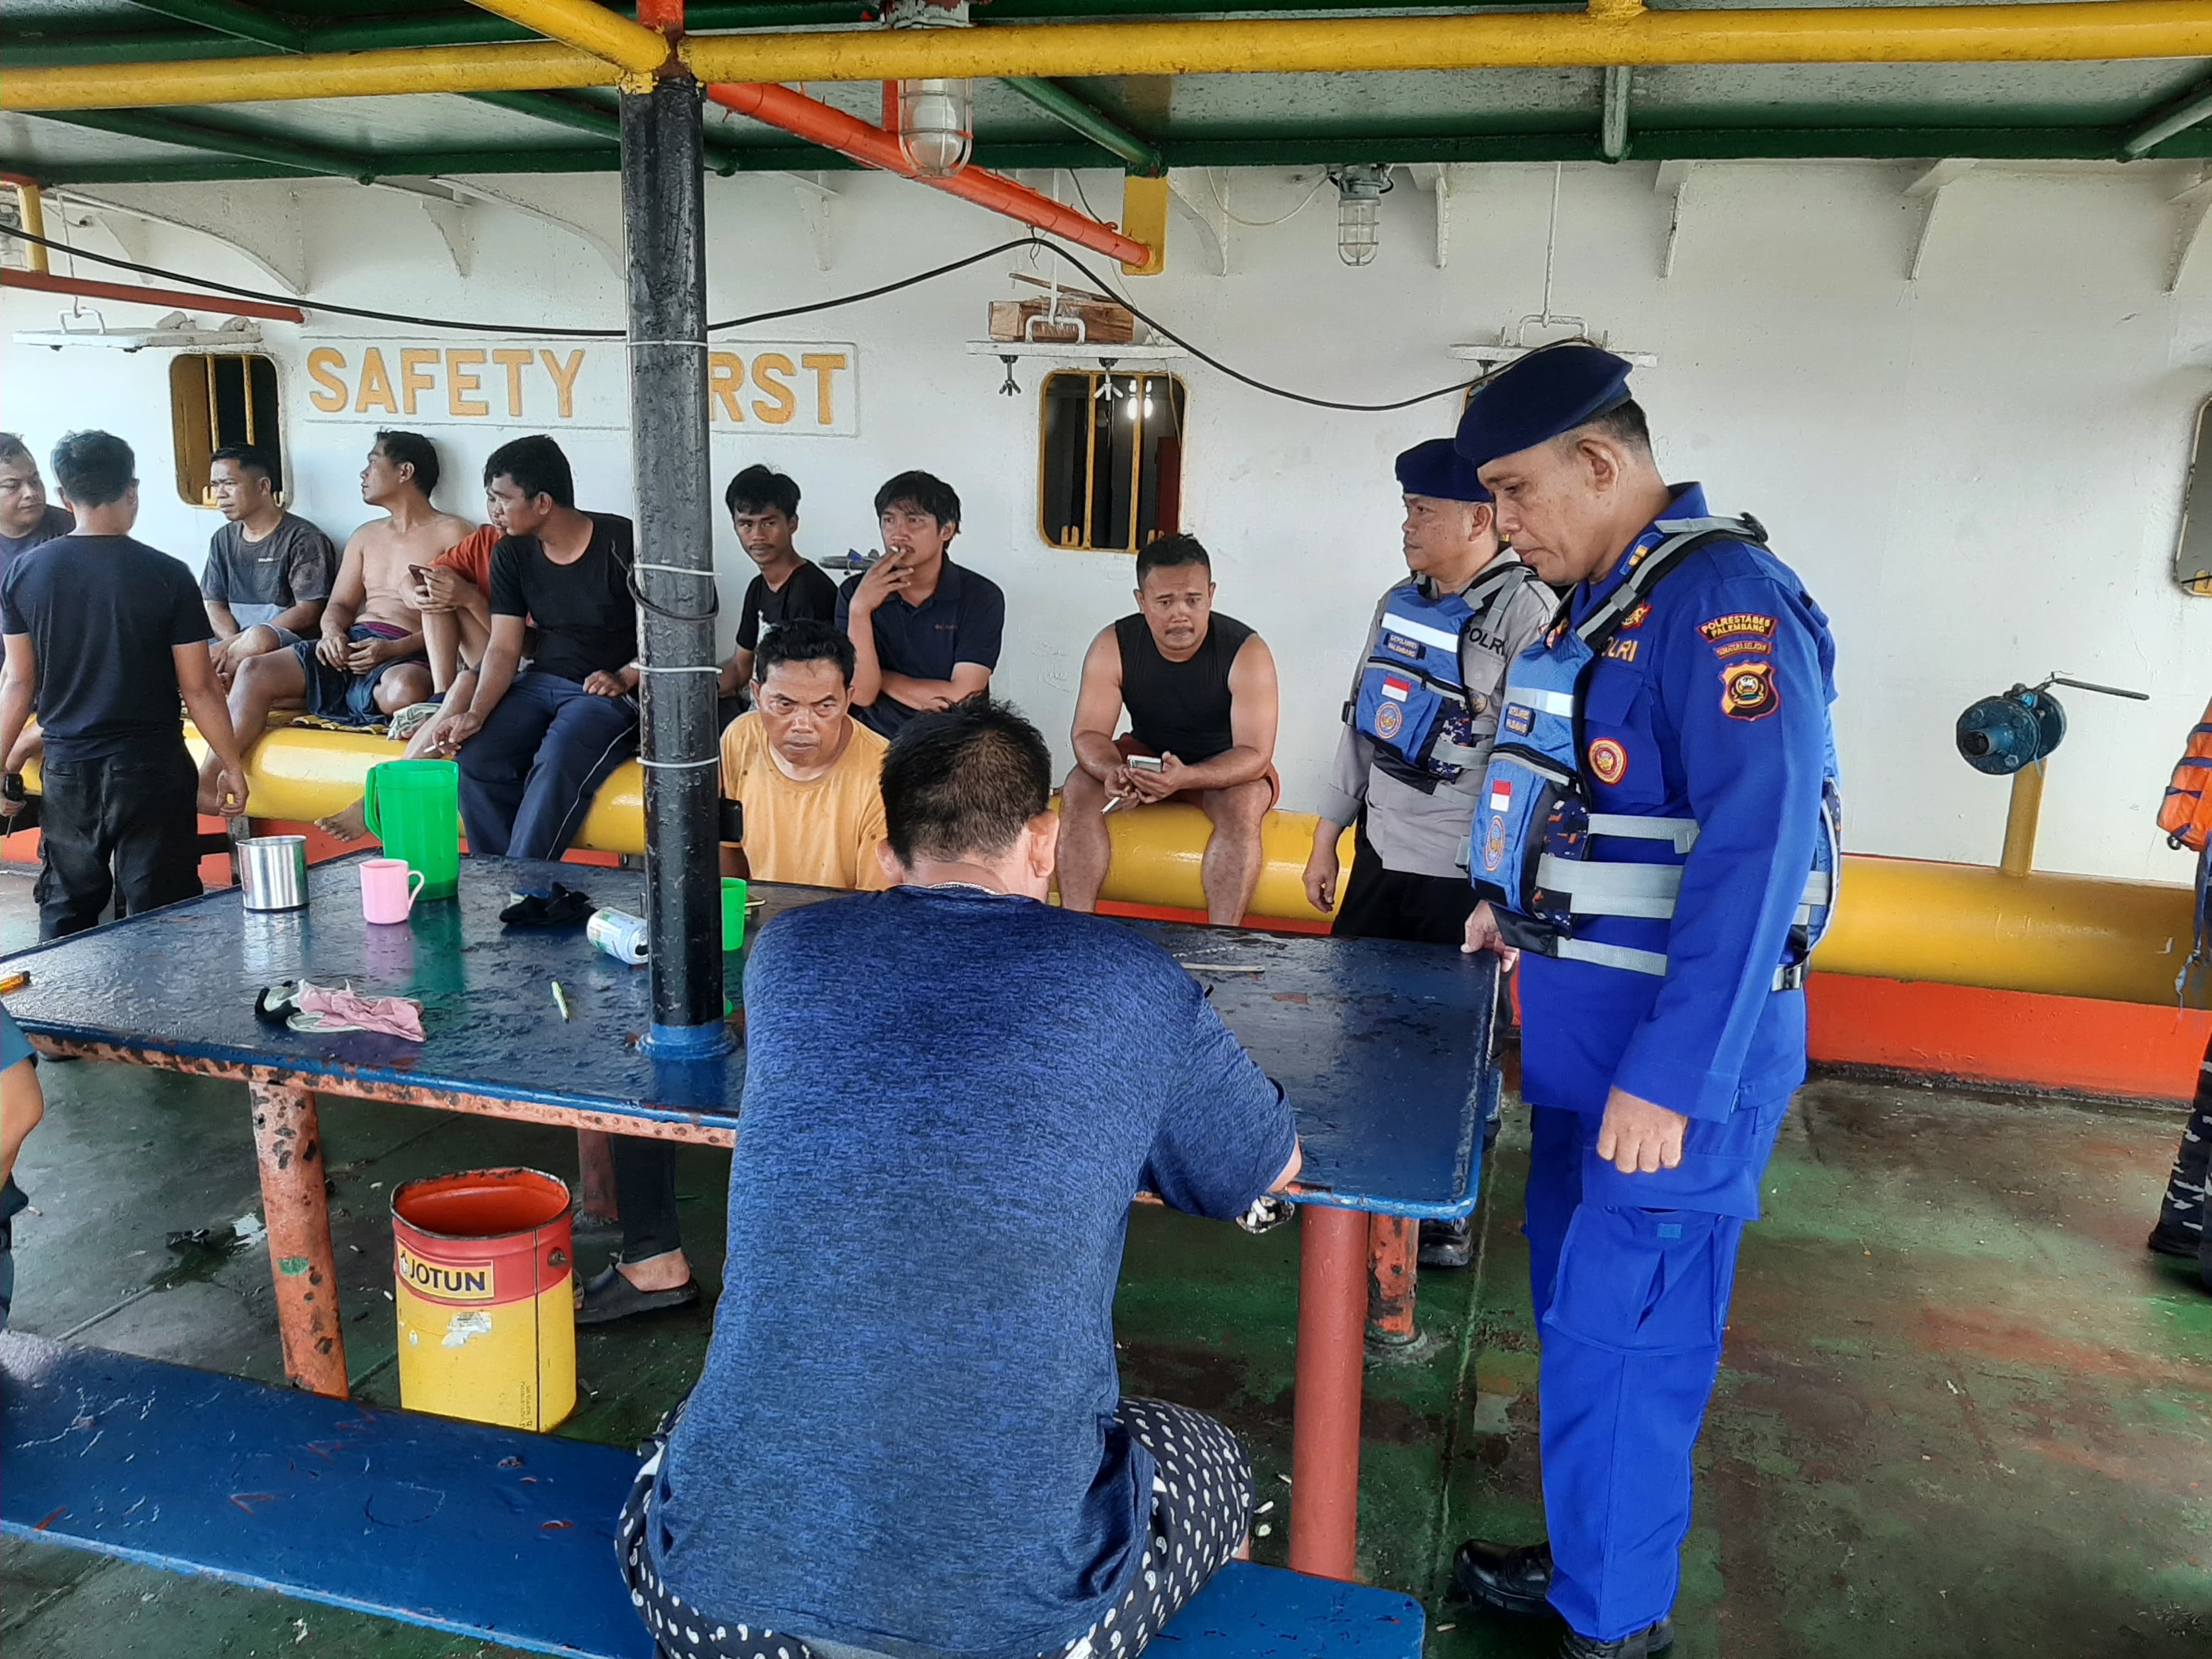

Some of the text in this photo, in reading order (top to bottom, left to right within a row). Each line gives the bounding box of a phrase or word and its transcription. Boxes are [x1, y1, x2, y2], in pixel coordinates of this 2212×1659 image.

[307, 347, 847, 425] SAFETY RST
[1701, 615, 1771, 634] POLRESTABES
[410, 1259, 485, 1291] JOTUN
